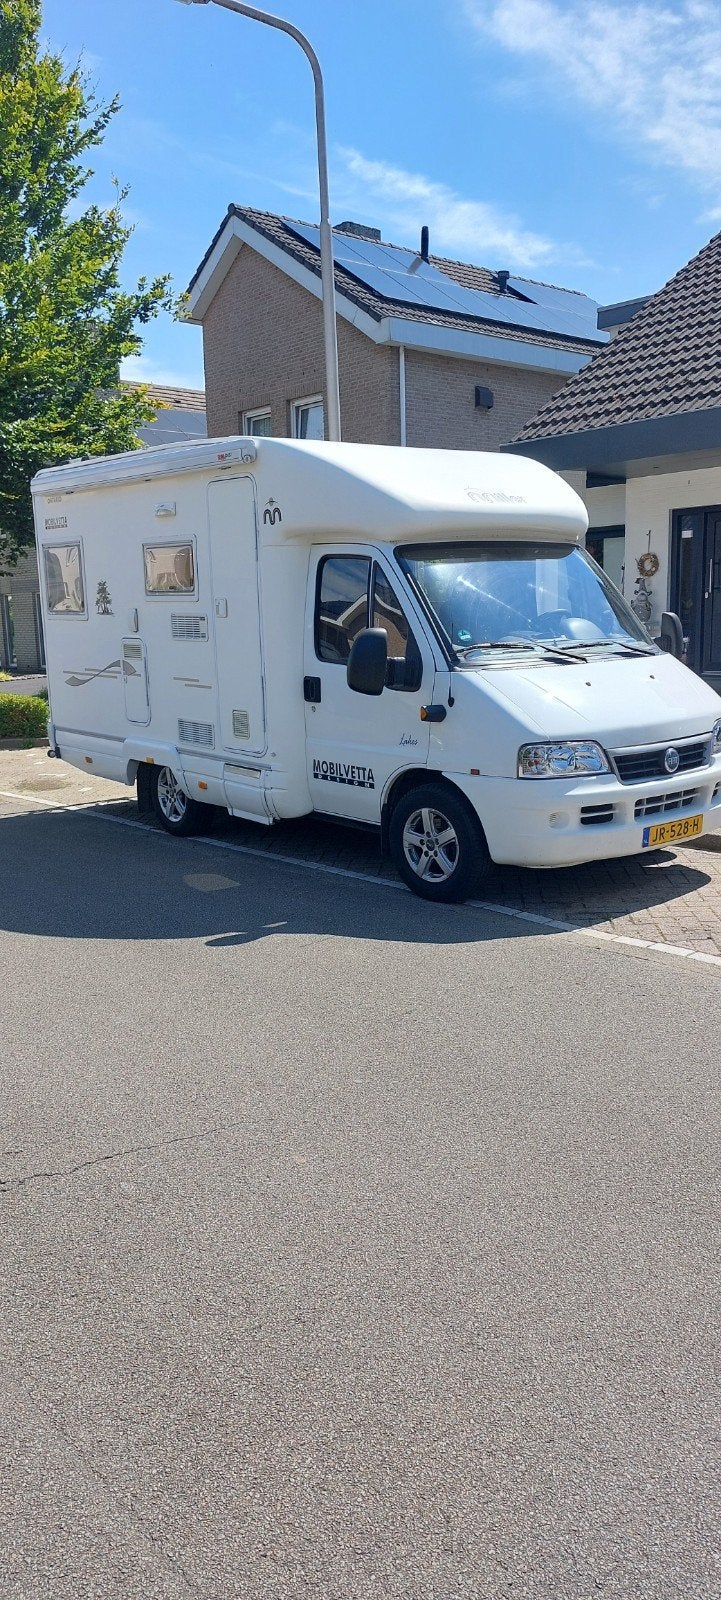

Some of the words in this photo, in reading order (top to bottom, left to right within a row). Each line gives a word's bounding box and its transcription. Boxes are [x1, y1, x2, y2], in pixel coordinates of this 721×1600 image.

[312, 759, 375, 782] MOBILVETTA
[317, 774, 371, 788] DESIGN
[653, 818, 699, 842] JR-528-H
